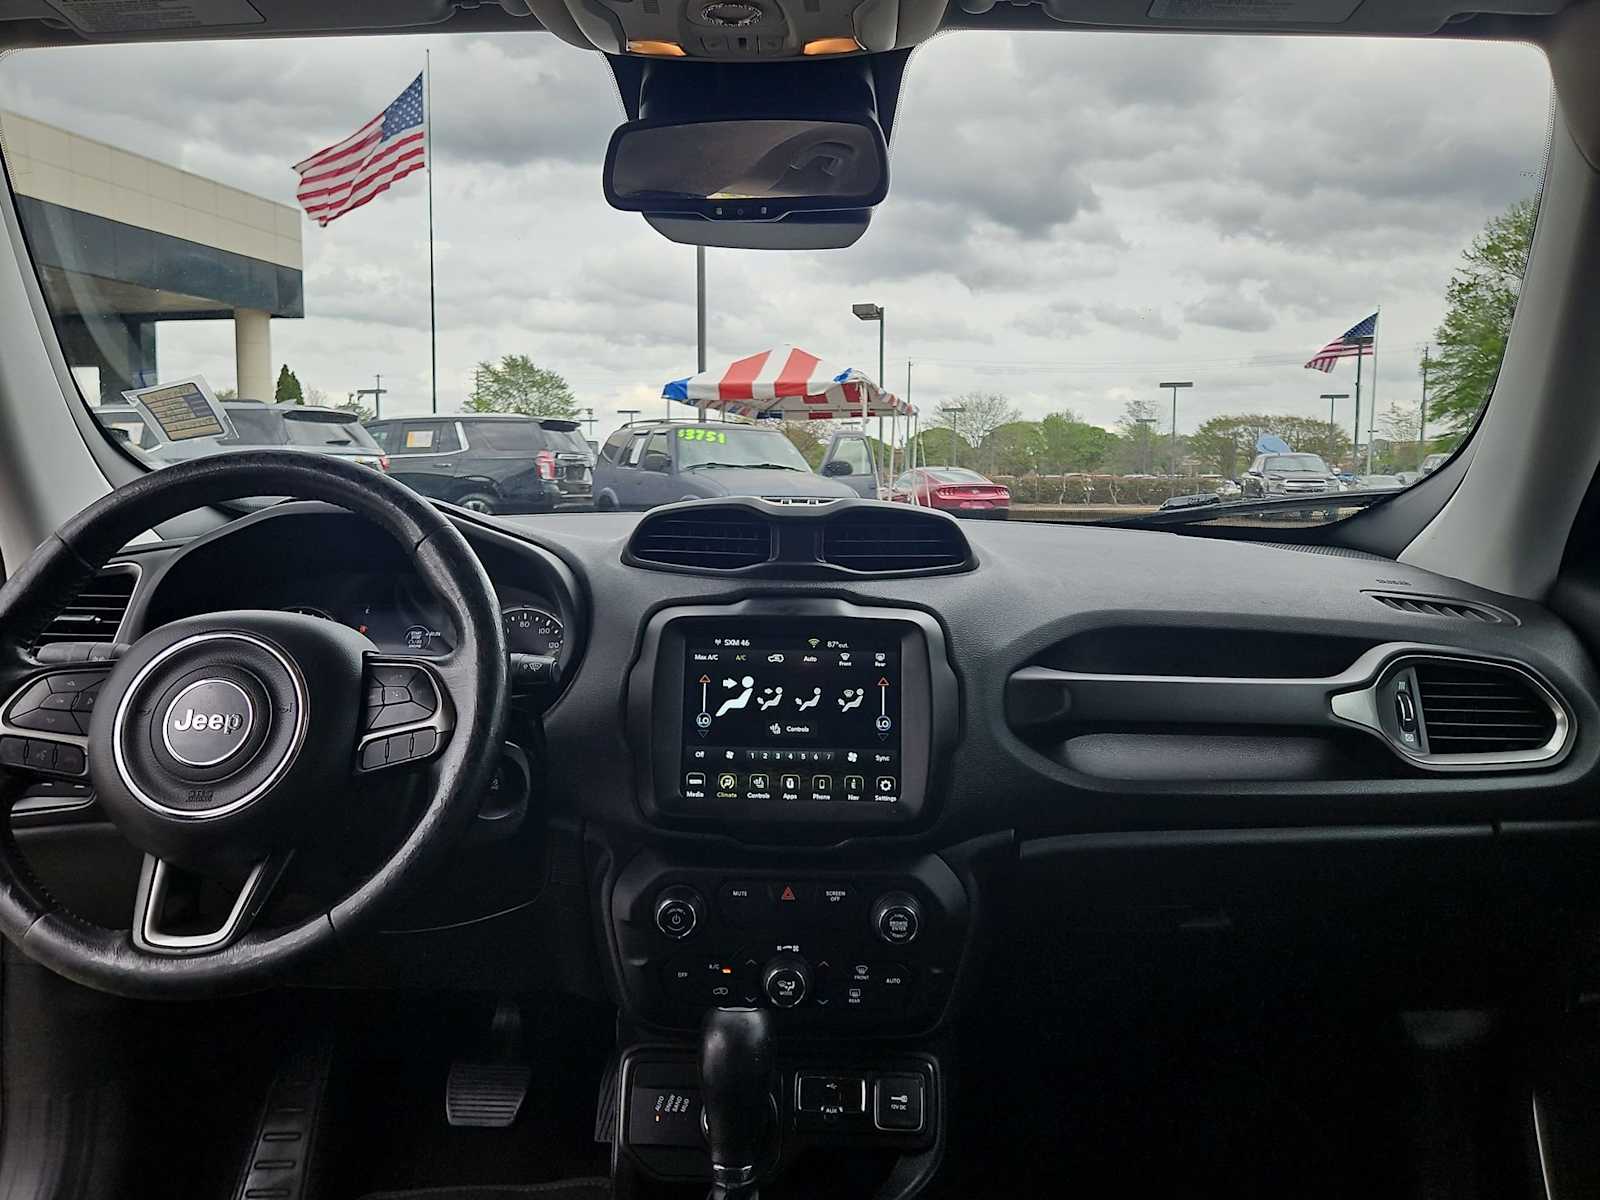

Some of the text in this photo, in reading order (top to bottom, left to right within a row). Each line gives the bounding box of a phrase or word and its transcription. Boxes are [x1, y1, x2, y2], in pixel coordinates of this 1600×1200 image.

[538, 627, 551, 635] 100
[724, 639, 751, 647] SXM 46
[694, 653, 719, 661] Max A/C
[803, 655, 818, 663] Auto
[174, 708, 243, 735] Jeep
[698, 716, 709, 725] LO
[878, 719, 889, 728] LO
[786, 724, 810, 734] Controls
[875, 754, 890, 762] Sync
[746, 792, 771, 800] Controls
[782, 793, 798, 801] Apps
[812, 793, 831, 801] Phone
[874, 795, 897, 803] Settings
[885, 977, 901, 985] AUTO
